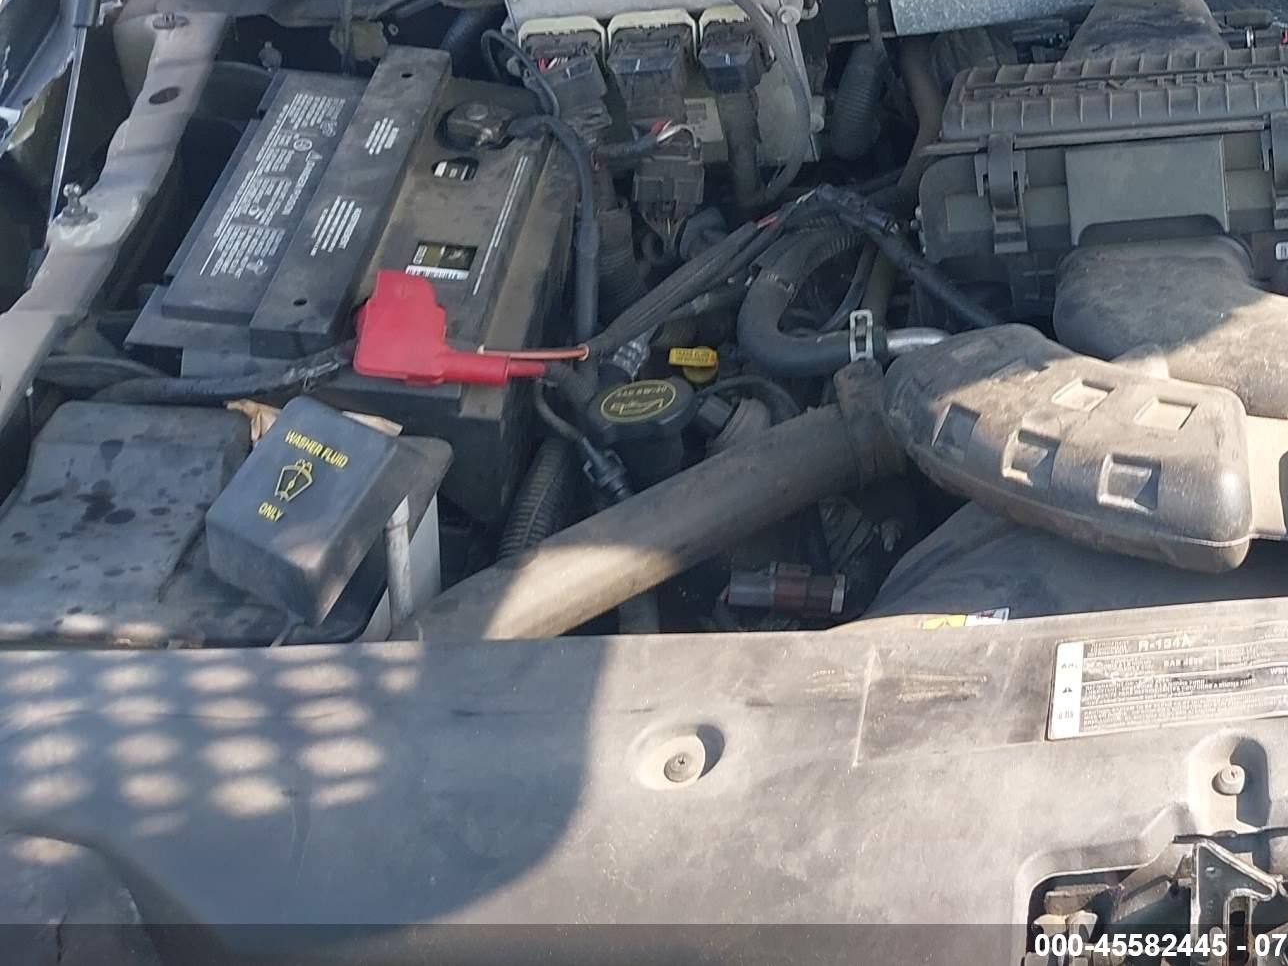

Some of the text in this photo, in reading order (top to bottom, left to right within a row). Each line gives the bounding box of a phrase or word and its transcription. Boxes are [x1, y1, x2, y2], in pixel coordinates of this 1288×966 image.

[284, 430, 349, 468] WASHER FLUID
[258, 503, 284, 522] ONLY
[1138, 634, 1191, 652] R-134A
